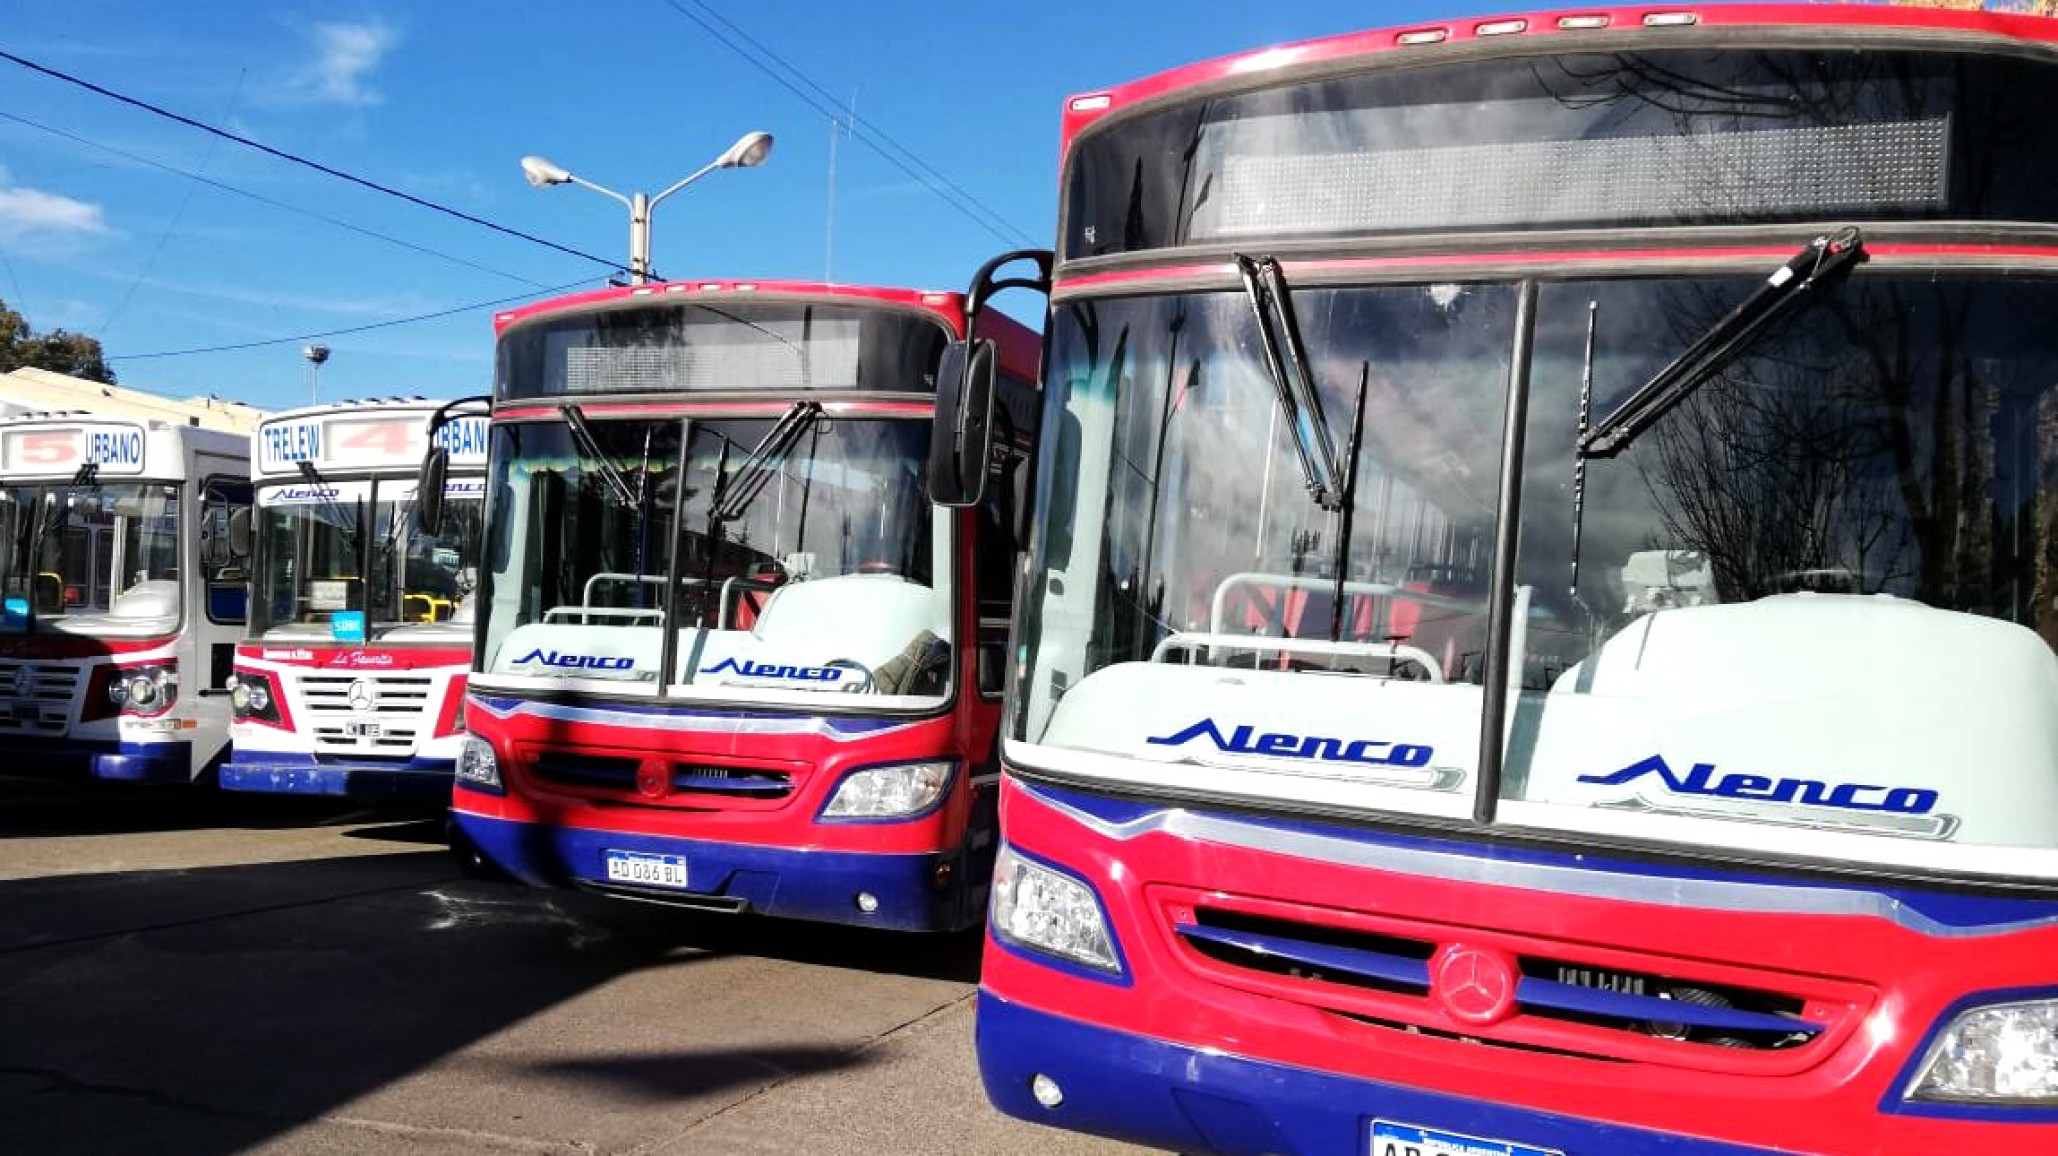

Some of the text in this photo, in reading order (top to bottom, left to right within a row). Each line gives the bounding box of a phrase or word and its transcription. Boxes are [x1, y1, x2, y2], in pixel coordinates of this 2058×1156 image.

[20, 432, 140, 463] 5 URBANO
[265, 420, 485, 462] TRELEW 4 RBAN
[512, 648, 634, 670] Alenco
[700, 657, 843, 682] Alenco
[1147, 717, 1434, 768] Alenco
[1578, 753, 1939, 817] Alenco
